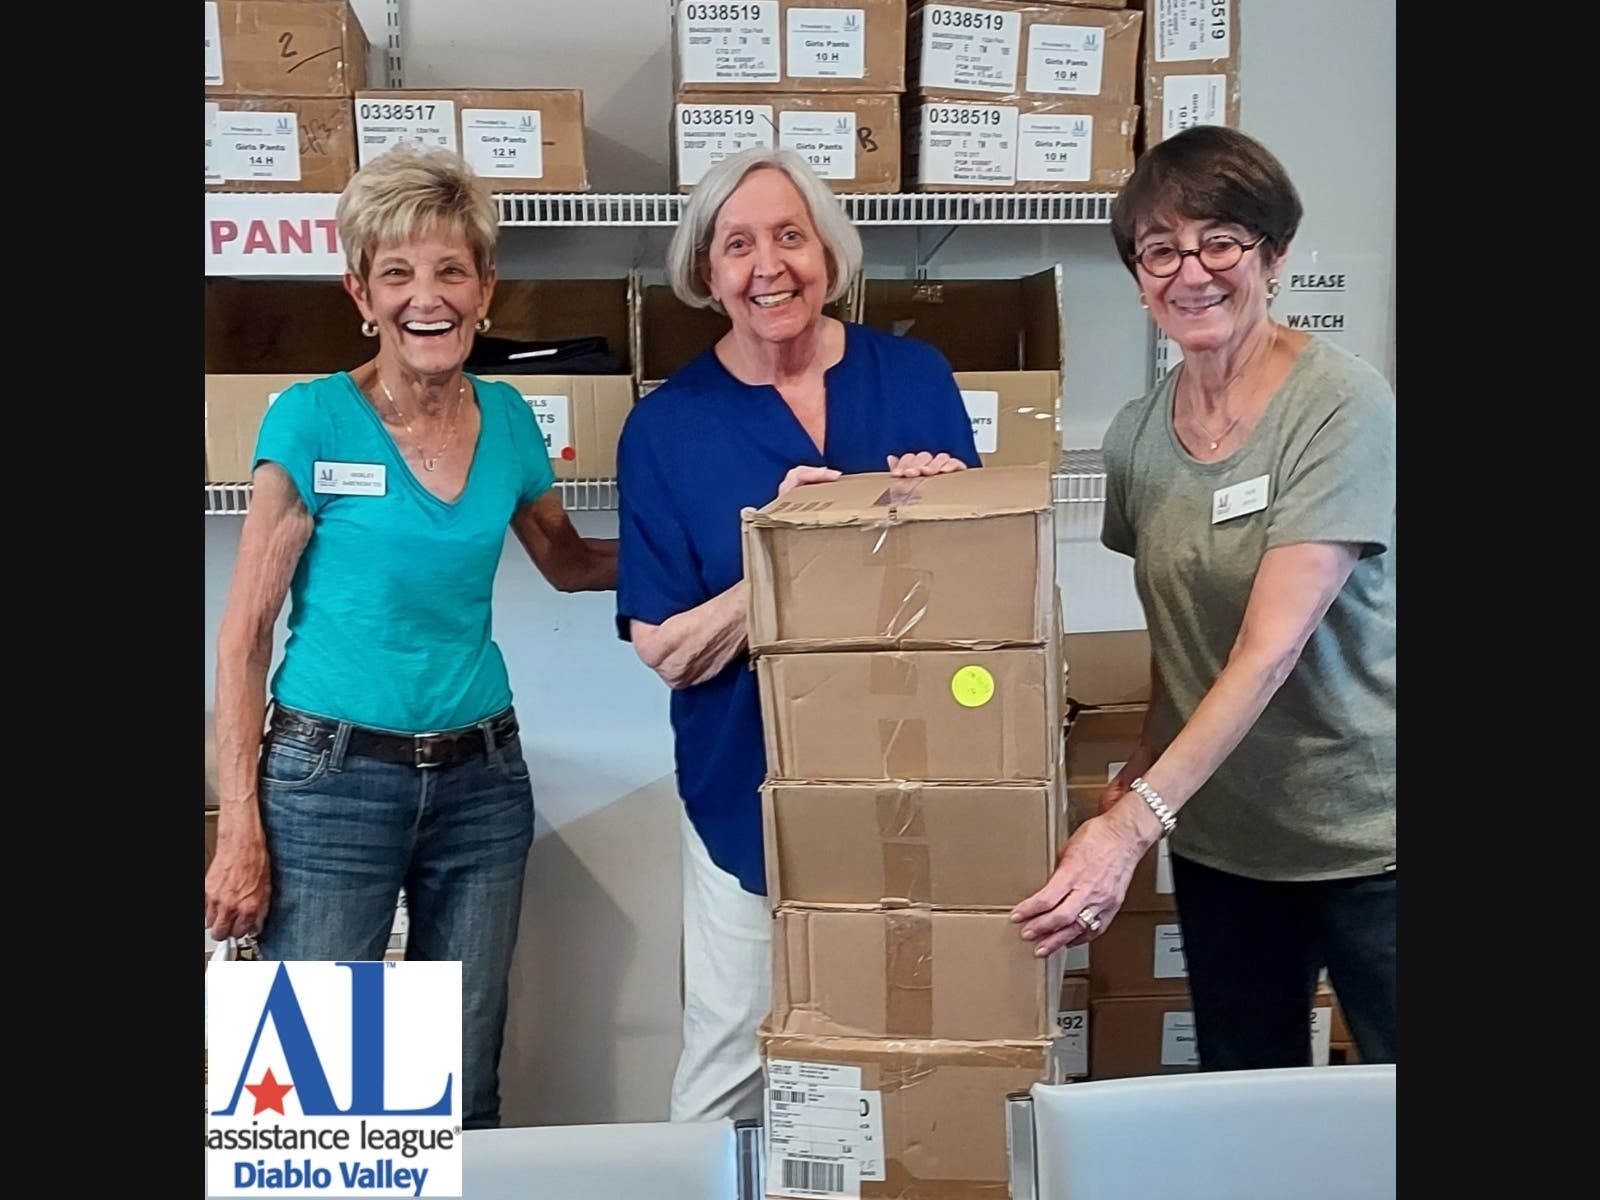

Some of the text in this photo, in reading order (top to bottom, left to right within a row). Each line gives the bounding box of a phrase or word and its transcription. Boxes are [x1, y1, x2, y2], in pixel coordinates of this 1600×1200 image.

[687, 5, 760, 20] 0338519
[932, 10, 1003, 30] 0338519
[816, 53, 839, 61] 10 H
[1055, 71, 1077, 79] 10 H
[361, 104, 435, 120] 0338517
[682, 109, 754, 125] 0338519
[929, 108, 1000, 125] 0338519
[1059, 153, 1067, 161] H
[1290, 274, 1346, 288] PLEASE
[1287, 314, 1344, 328] WATCH
